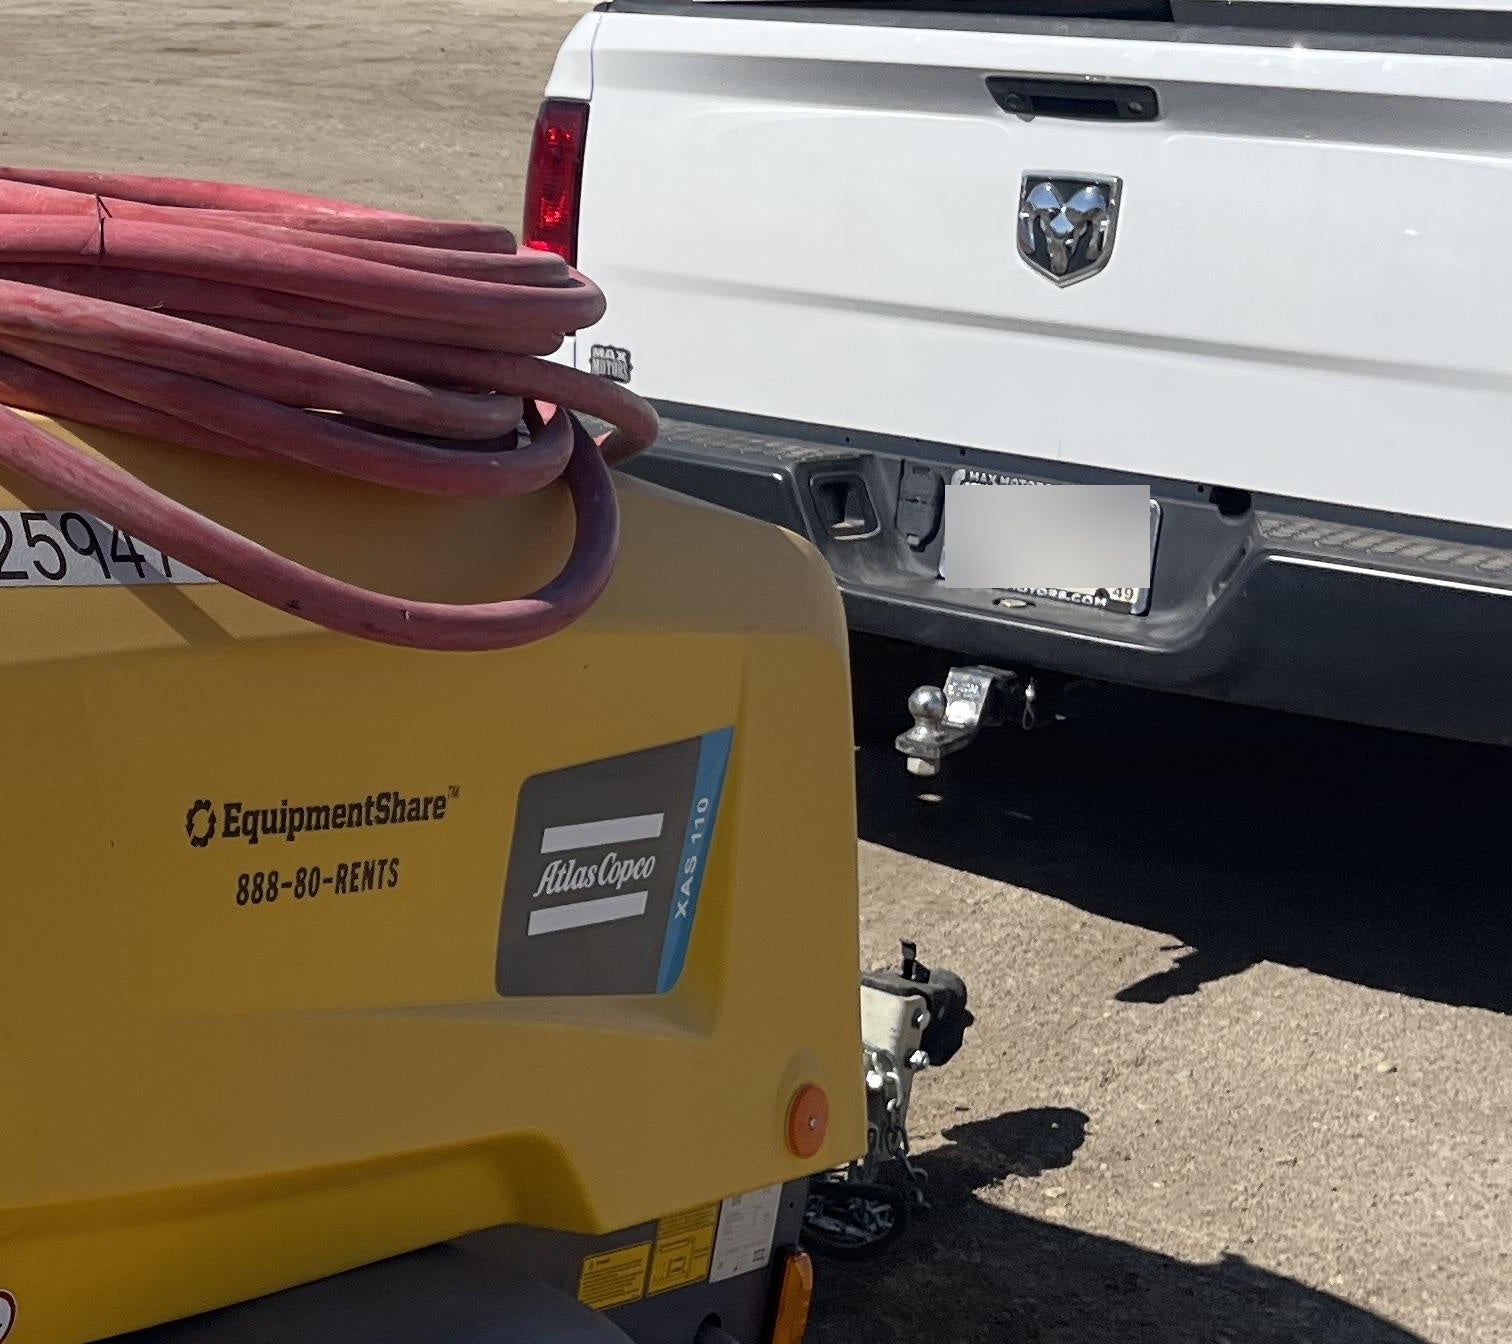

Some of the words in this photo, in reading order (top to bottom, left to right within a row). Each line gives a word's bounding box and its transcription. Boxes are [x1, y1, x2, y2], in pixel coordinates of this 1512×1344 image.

[221, 791, 448, 845] EquipmentShare
[235, 857, 400, 907] 888-80-RENTS
[674, 855, 698, 919] XAS
[691, 797, 710, 845] 110
